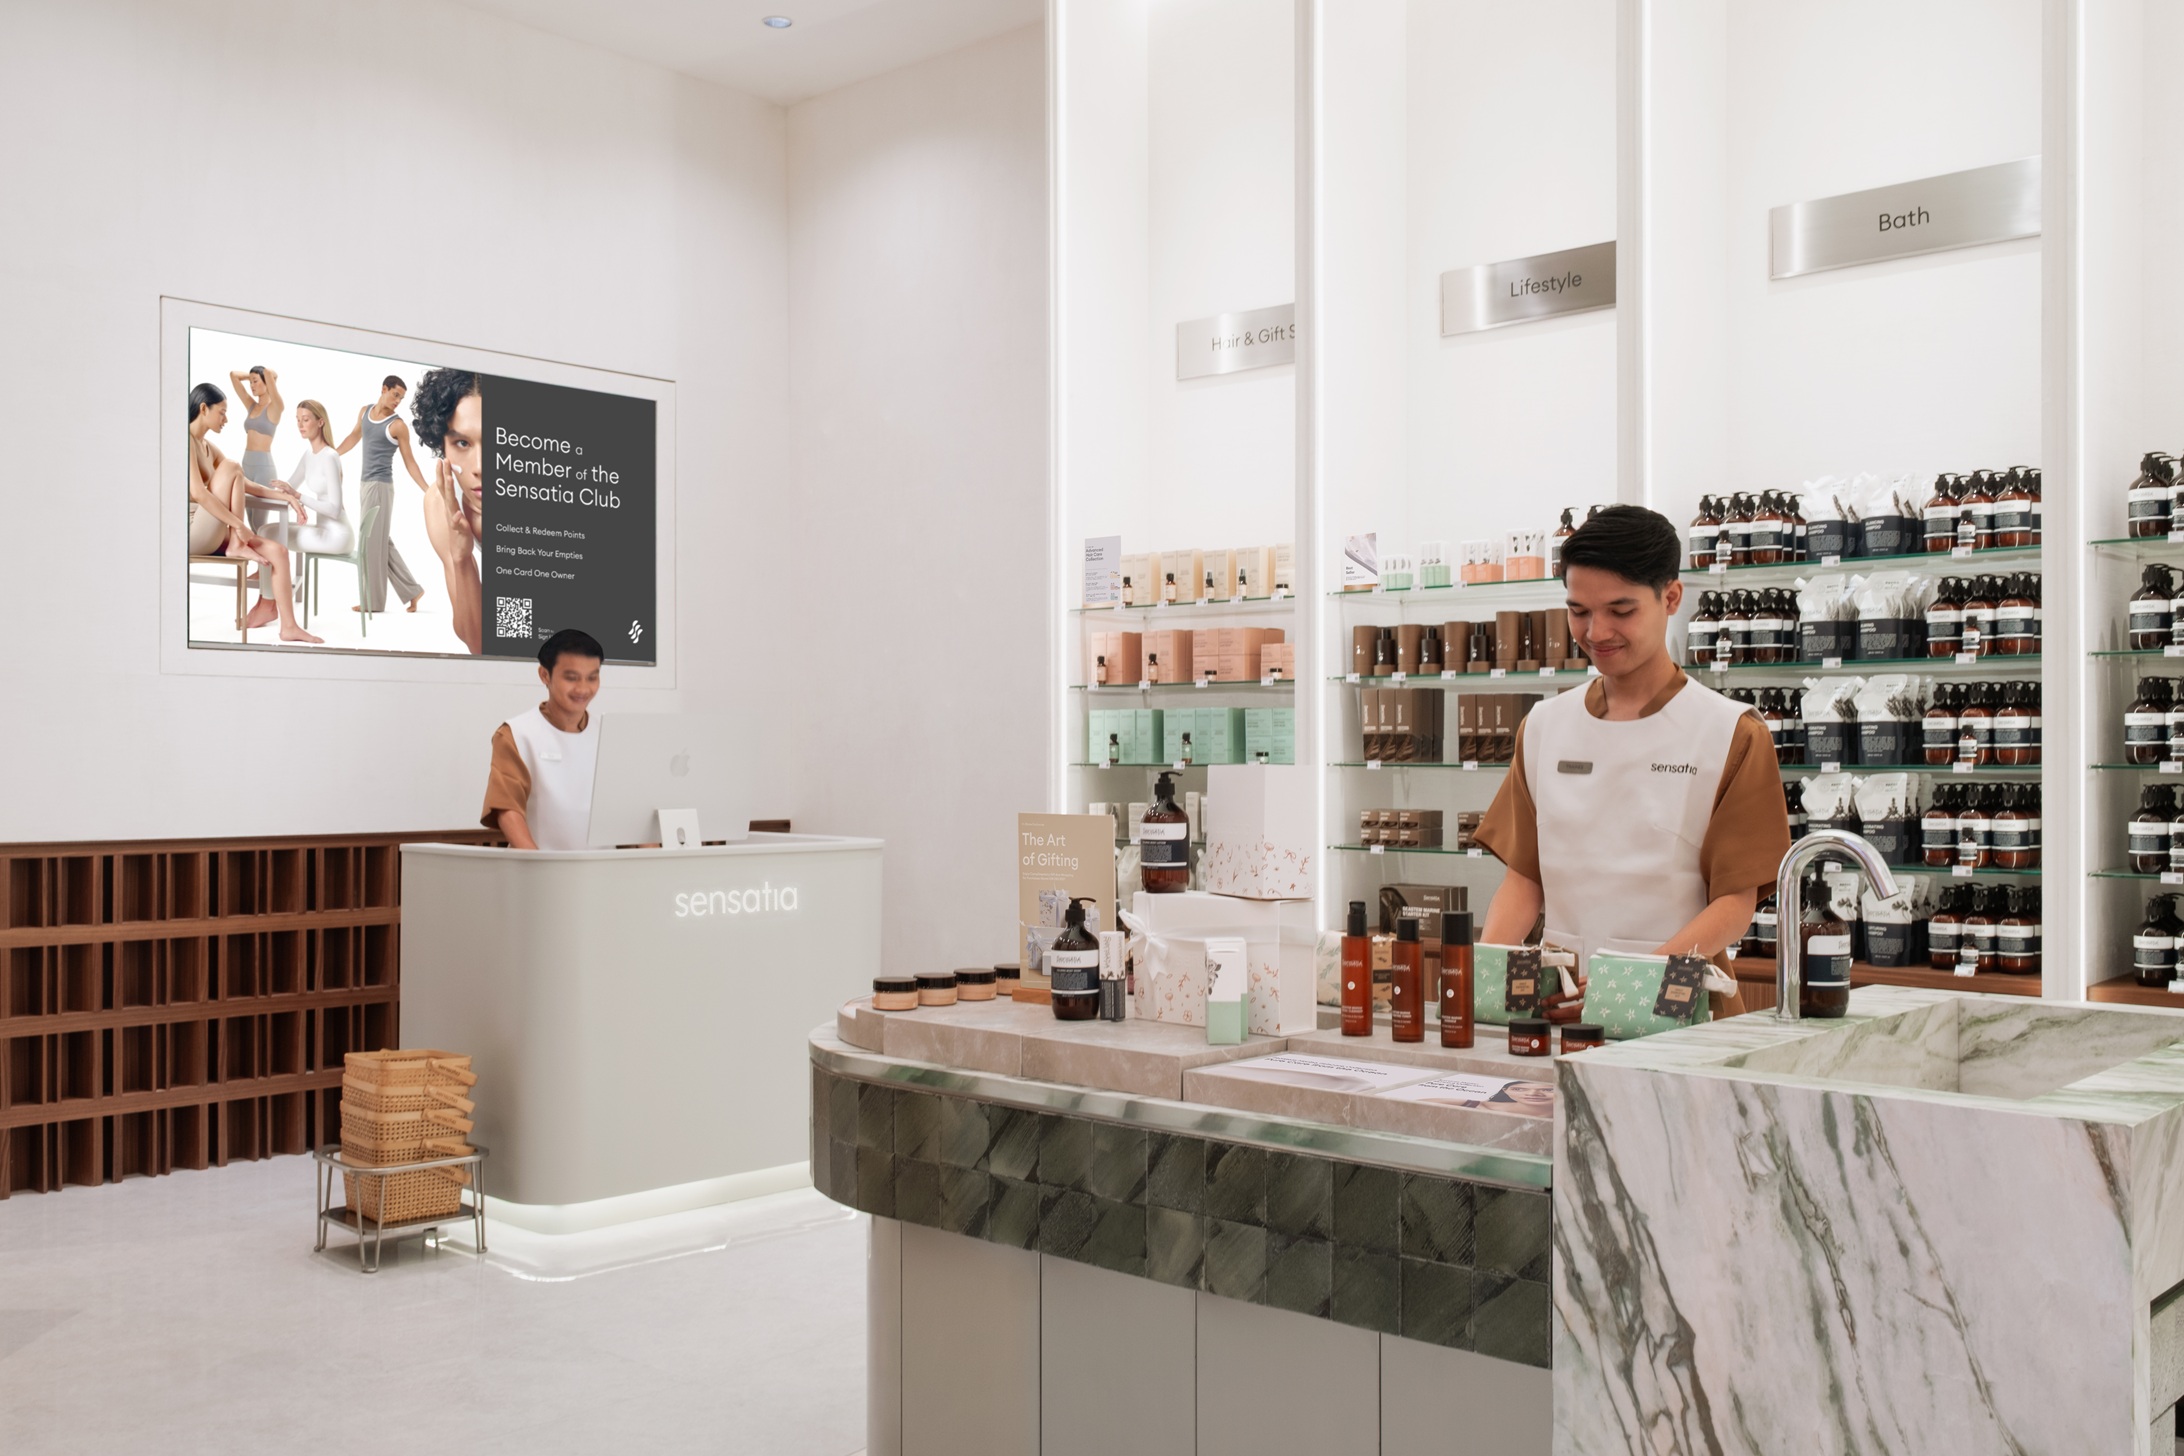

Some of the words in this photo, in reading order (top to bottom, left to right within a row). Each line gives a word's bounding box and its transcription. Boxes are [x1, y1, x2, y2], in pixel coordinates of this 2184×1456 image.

[1879, 206, 1930, 232] Bath
[1510, 271, 1582, 298] Lifestyle
[1212, 334, 1240, 352] Hair
[1244, 331, 1254, 346] &
[1258, 326, 1285, 344] Gift
[496, 426, 571, 454] Become
[575, 446, 583, 456] a
[496, 452, 572, 479] Member
[576, 469, 588, 480] of
[591, 464, 620, 484] the
[495, 478, 574, 504] Sensatia
[580, 488, 620, 509] Club
[496, 523, 524, 534] Collect
[524, 526, 532, 534] &
[532, 527, 562, 538] Redeem
[564, 530, 586, 540] Points
[496, 545, 516, 556] Bring
[518, 547, 536, 556] Back
[538, 548, 554, 558] Your
[555, 550, 584, 560] Empties
[496, 566, 512, 575] One
[514, 568, 532, 577] Card
[534, 570, 550, 578] One
[551, 571, 575, 580] Owner
[1651, 762, 1698, 776] sensatia
[1022, 832, 1044, 846] The
[1047, 833, 1066, 847] Art
[1022, 852, 1034, 866] of
[1038, 852, 1079, 870] Gifting
[674, 881, 798, 918] sensatia
